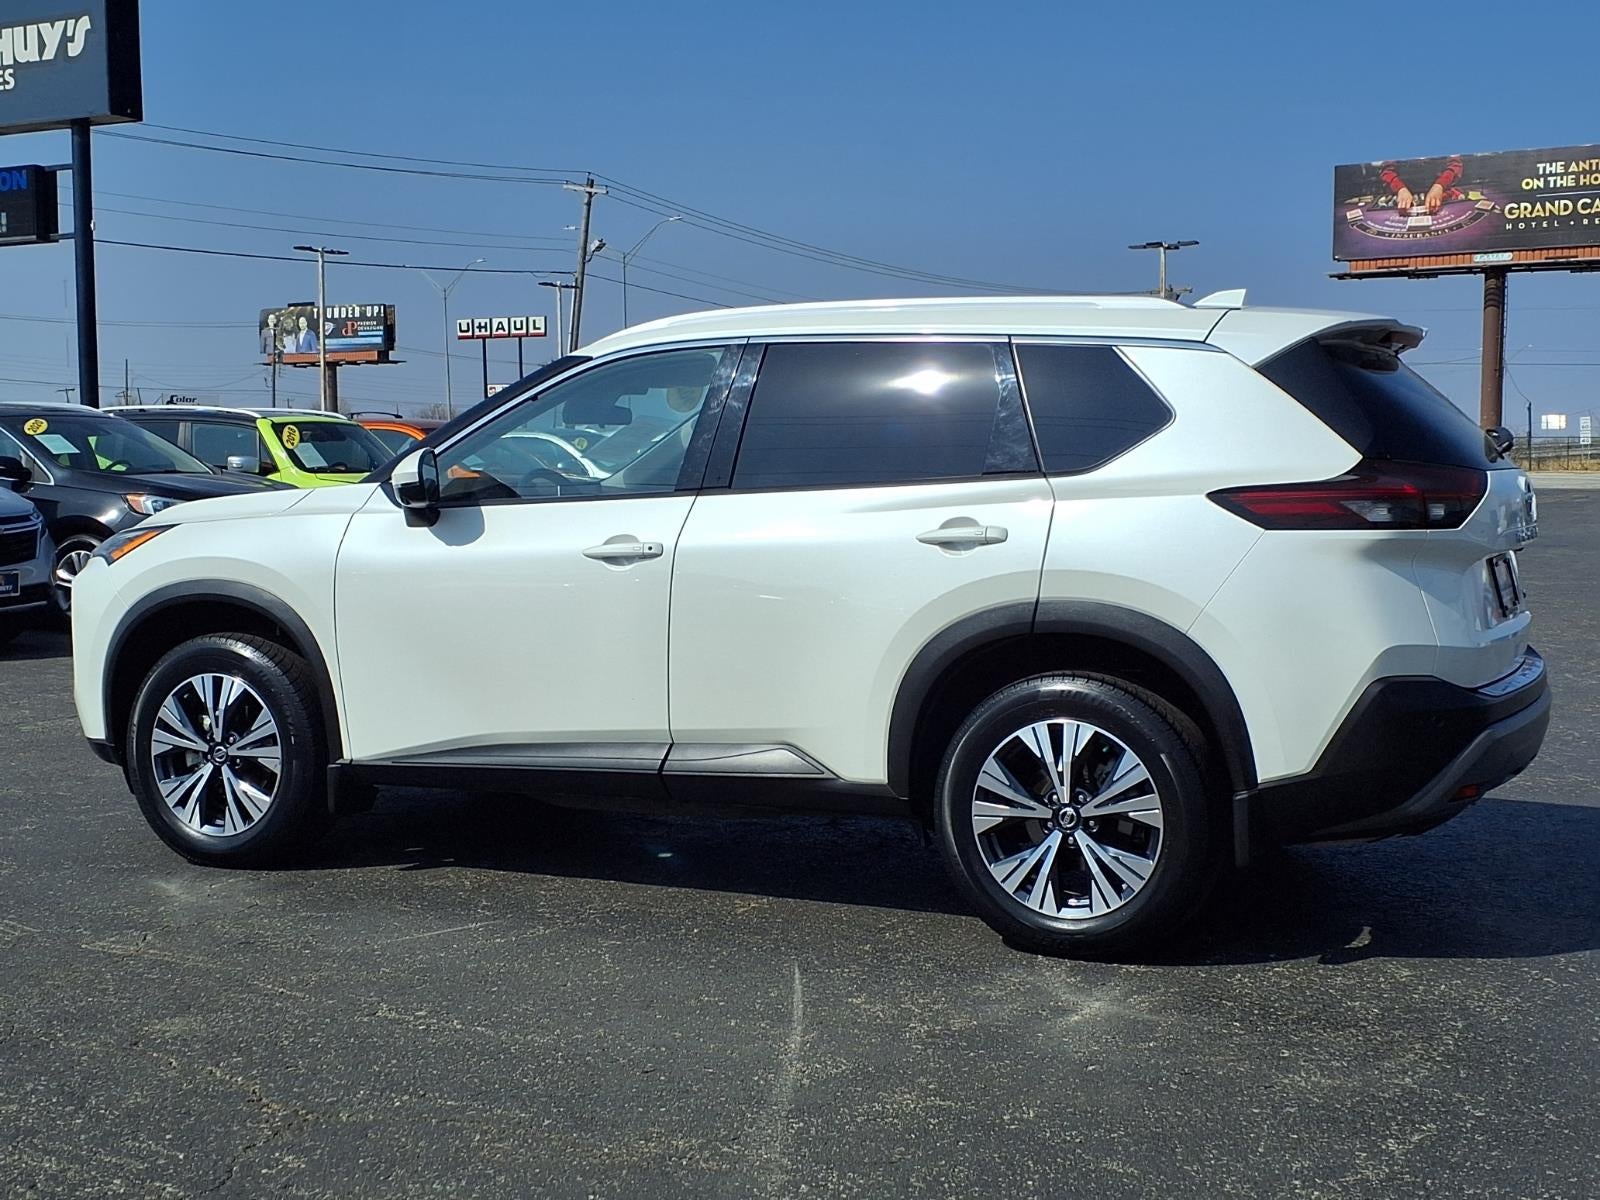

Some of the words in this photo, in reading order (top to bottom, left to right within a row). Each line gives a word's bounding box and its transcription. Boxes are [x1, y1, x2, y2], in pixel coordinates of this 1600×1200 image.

[1536, 161, 1566, 175] THE
[1567, 159, 1600, 172] ANT
[1521, 177, 1545, 190] ON
[1547, 174, 1577, 188] THE
[1503, 199, 1574, 219] GRAND
[1505, 220, 1560, 231] HOTEL
[312, 306, 360, 319] TUNDER
[366, 305, 385, 317] UP!
[166, 394, 198, 405] Color
